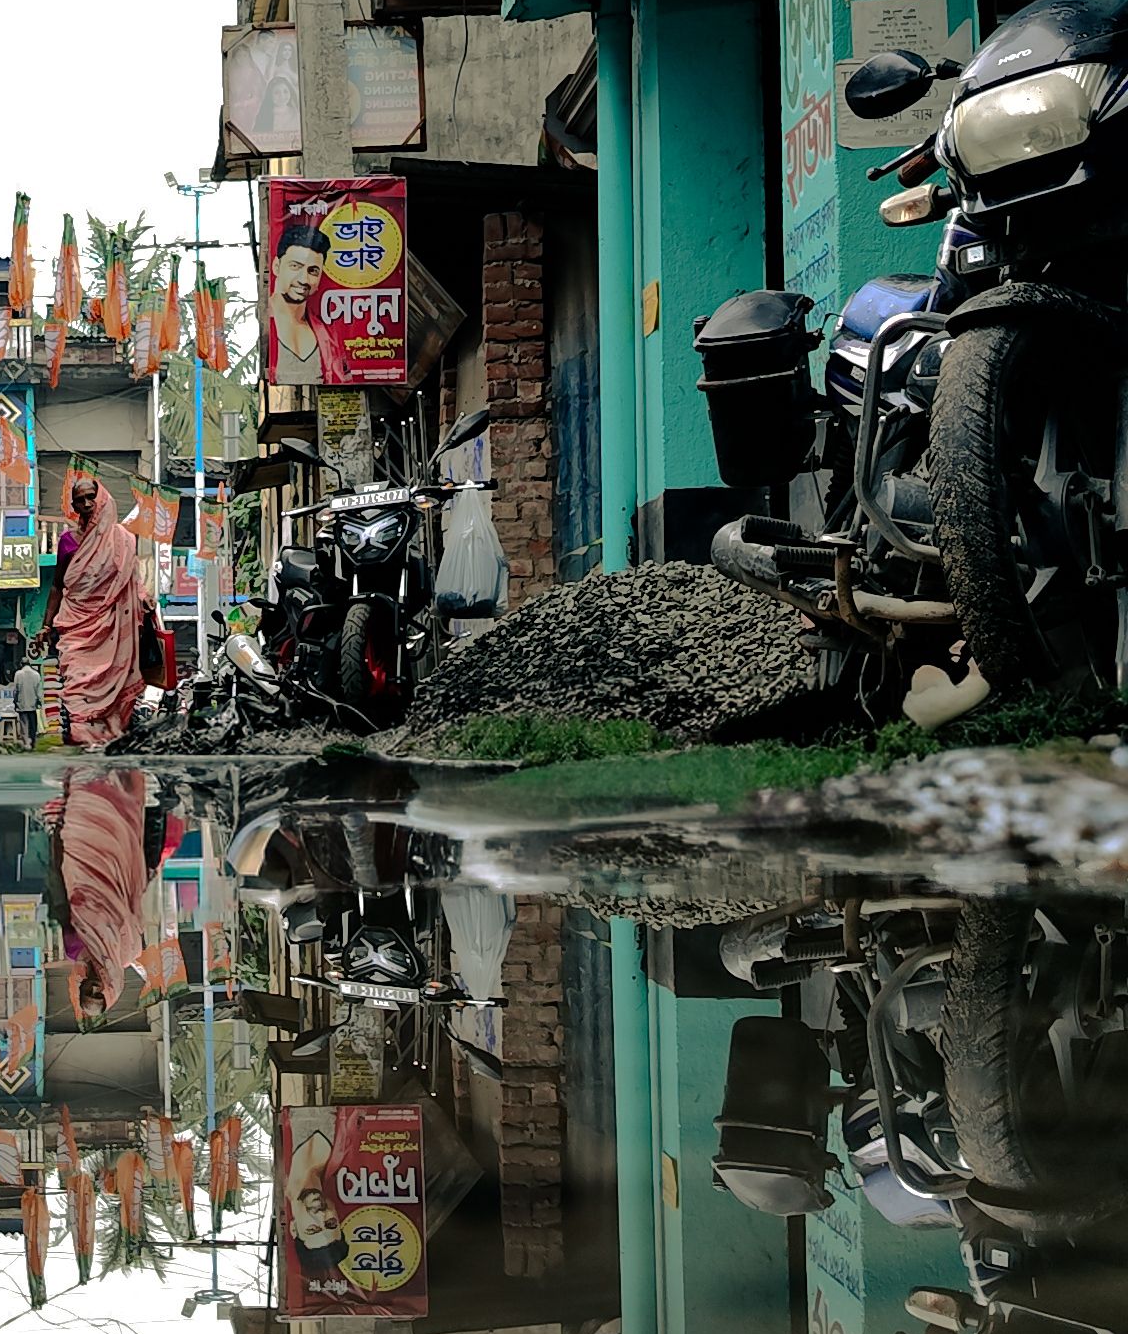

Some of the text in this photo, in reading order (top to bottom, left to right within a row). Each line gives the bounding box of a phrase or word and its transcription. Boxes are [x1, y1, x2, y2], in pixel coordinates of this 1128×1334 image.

[784, 88, 833, 210] হাউস
[333, 215, 385, 244] ভাই
[333, 243, 385, 272] ভাই
[320, 287, 401, 335] সেলুন
[14, 543, 33, 560] হল
